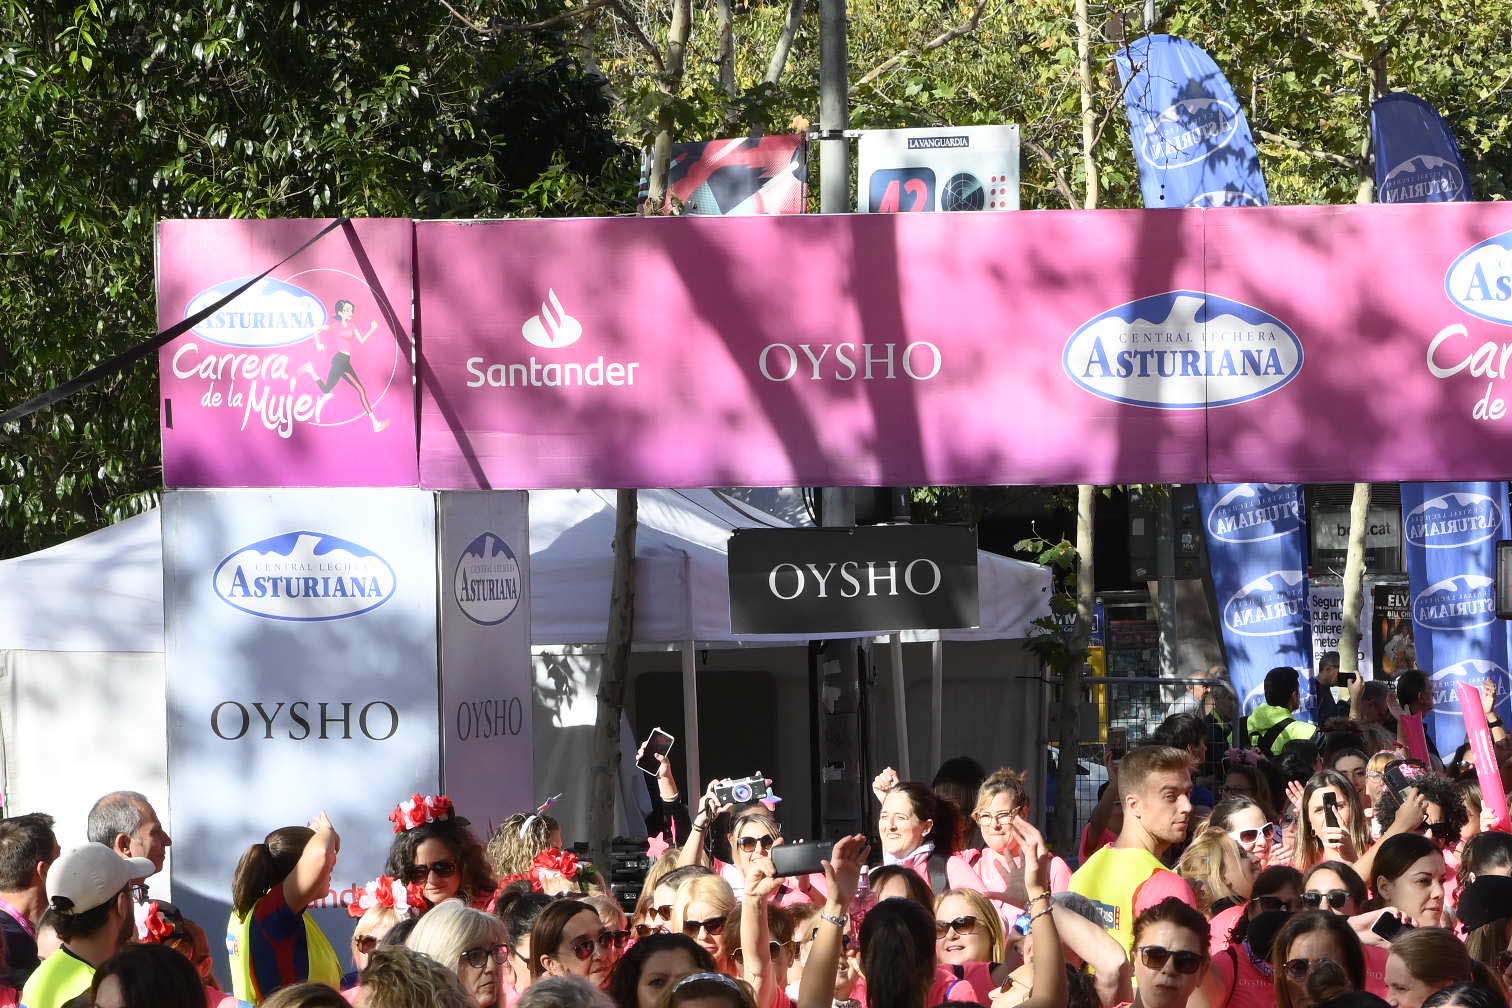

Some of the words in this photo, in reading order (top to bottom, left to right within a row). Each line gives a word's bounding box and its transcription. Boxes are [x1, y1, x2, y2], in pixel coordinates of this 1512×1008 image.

[1081, 335, 1285, 378] ASTURIANA
[1118, 331, 1193, 344] CENTRAL
[172, 343, 289, 380] Carrera
[466, 356, 640, 388] Santander
[758, 340, 942, 382] OYSHO
[201, 381, 222, 407] de
[228, 381, 243, 407] la
[241, 378, 335, 439] Mujer
[1472, 382, 1507, 420] de
[228, 564, 384, 599] ASTURIANA
[460, 567, 518, 602] ASTURIANA
[769, 558, 942, 601] OYSHO
[210, 701, 400, 741] OYSHO
[457, 697, 523, 742] OYSHO
